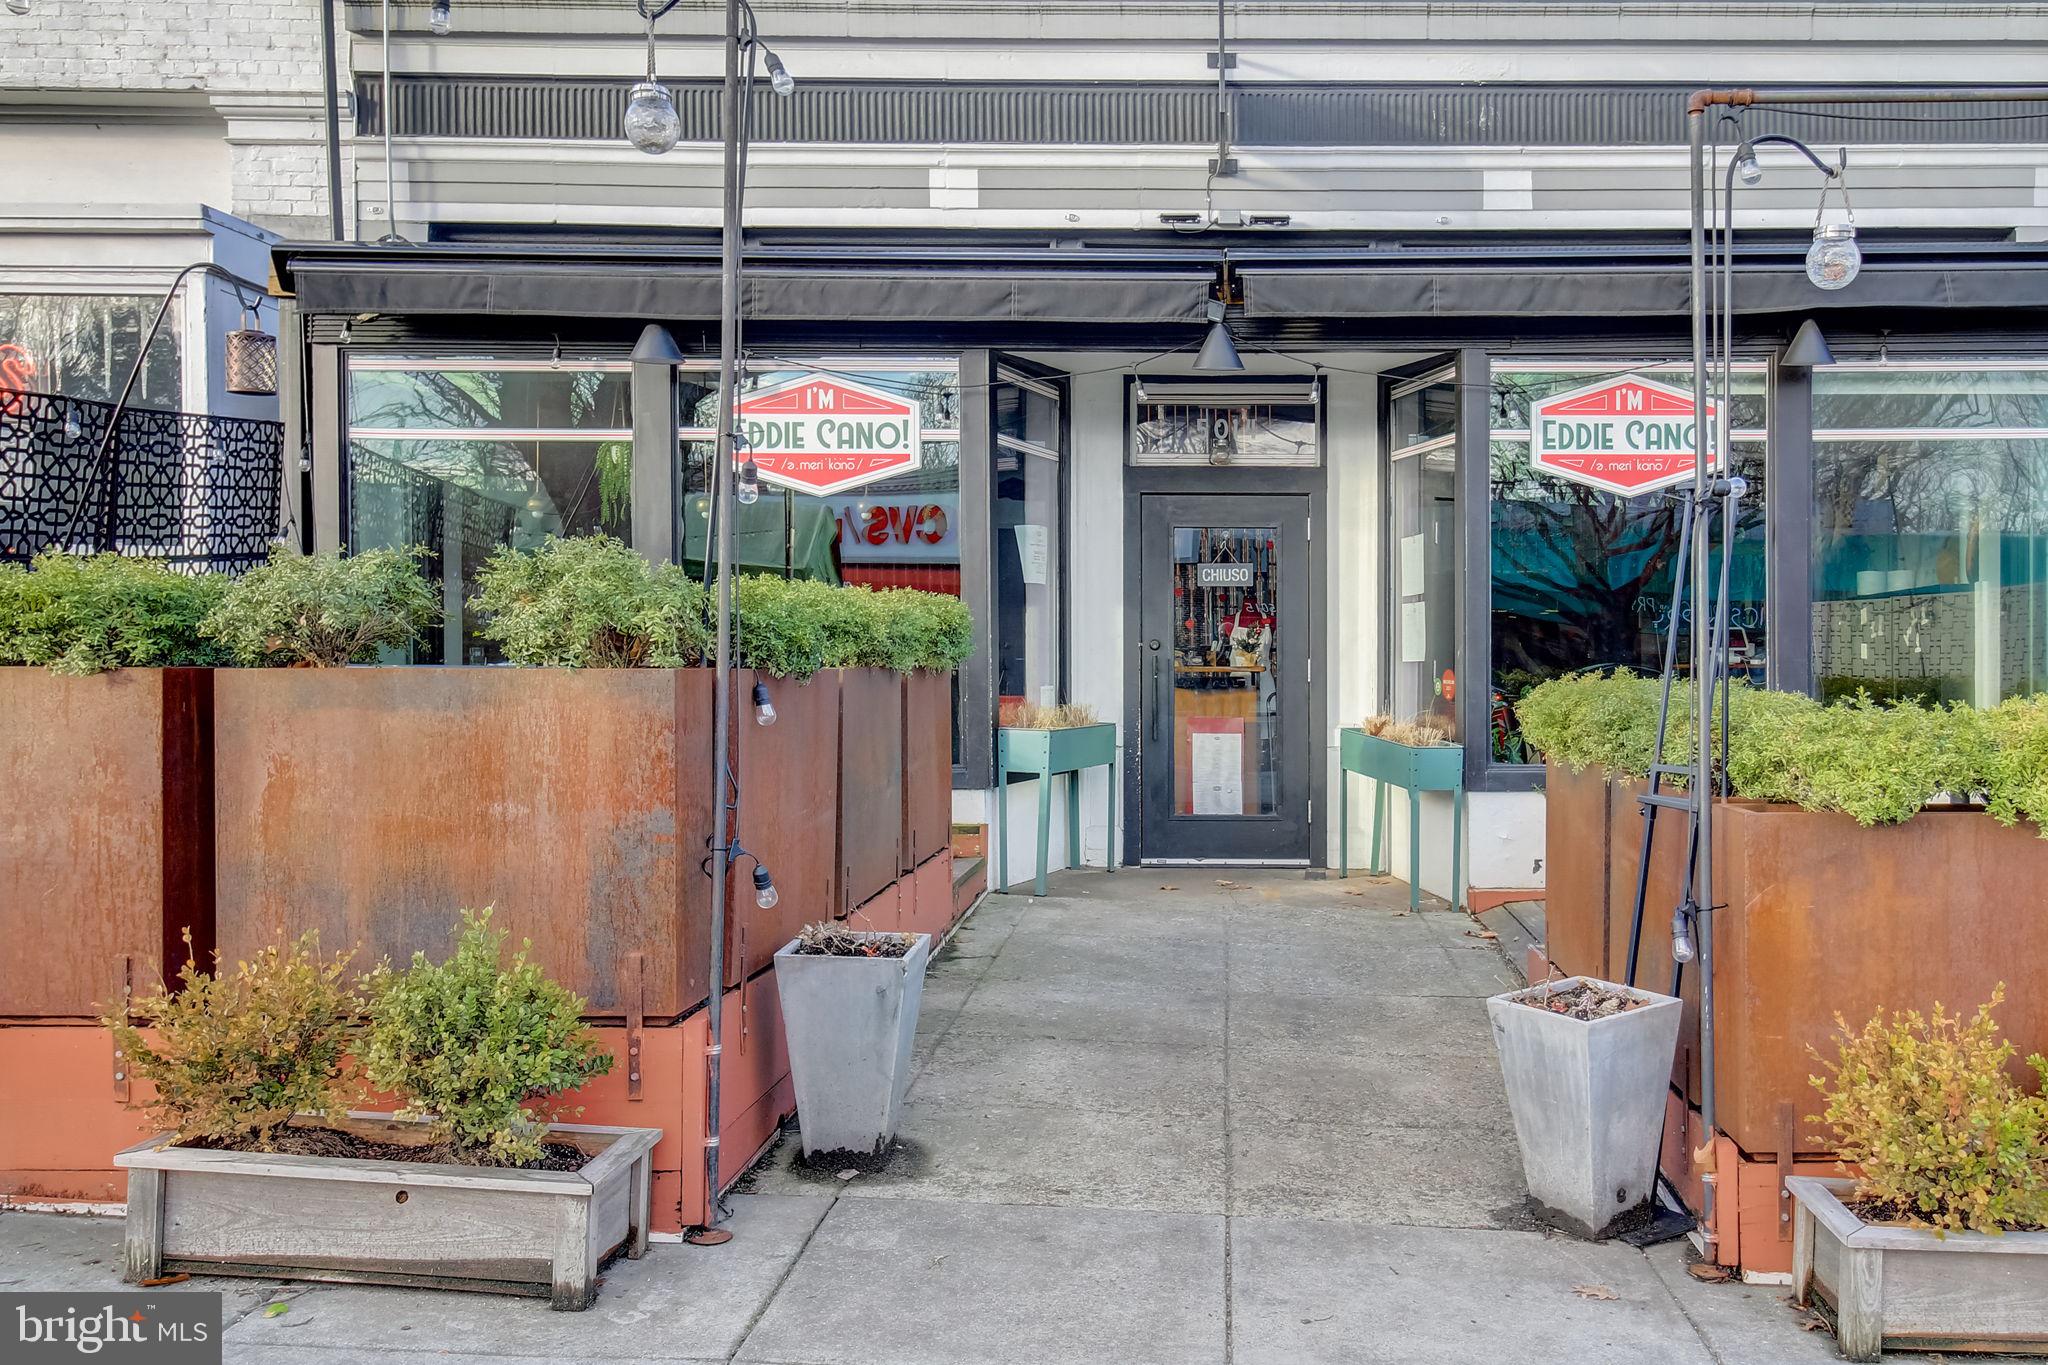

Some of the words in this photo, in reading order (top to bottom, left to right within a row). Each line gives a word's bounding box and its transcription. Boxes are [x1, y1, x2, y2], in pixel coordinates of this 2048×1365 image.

[806, 387, 834, 410] I'M
[1615, 388, 1643, 411] I'M
[816, 418, 909, 450] CANO!
[1542, 419, 1614, 450] EDDIE
[1202, 567, 1249, 582] CHIUSO
